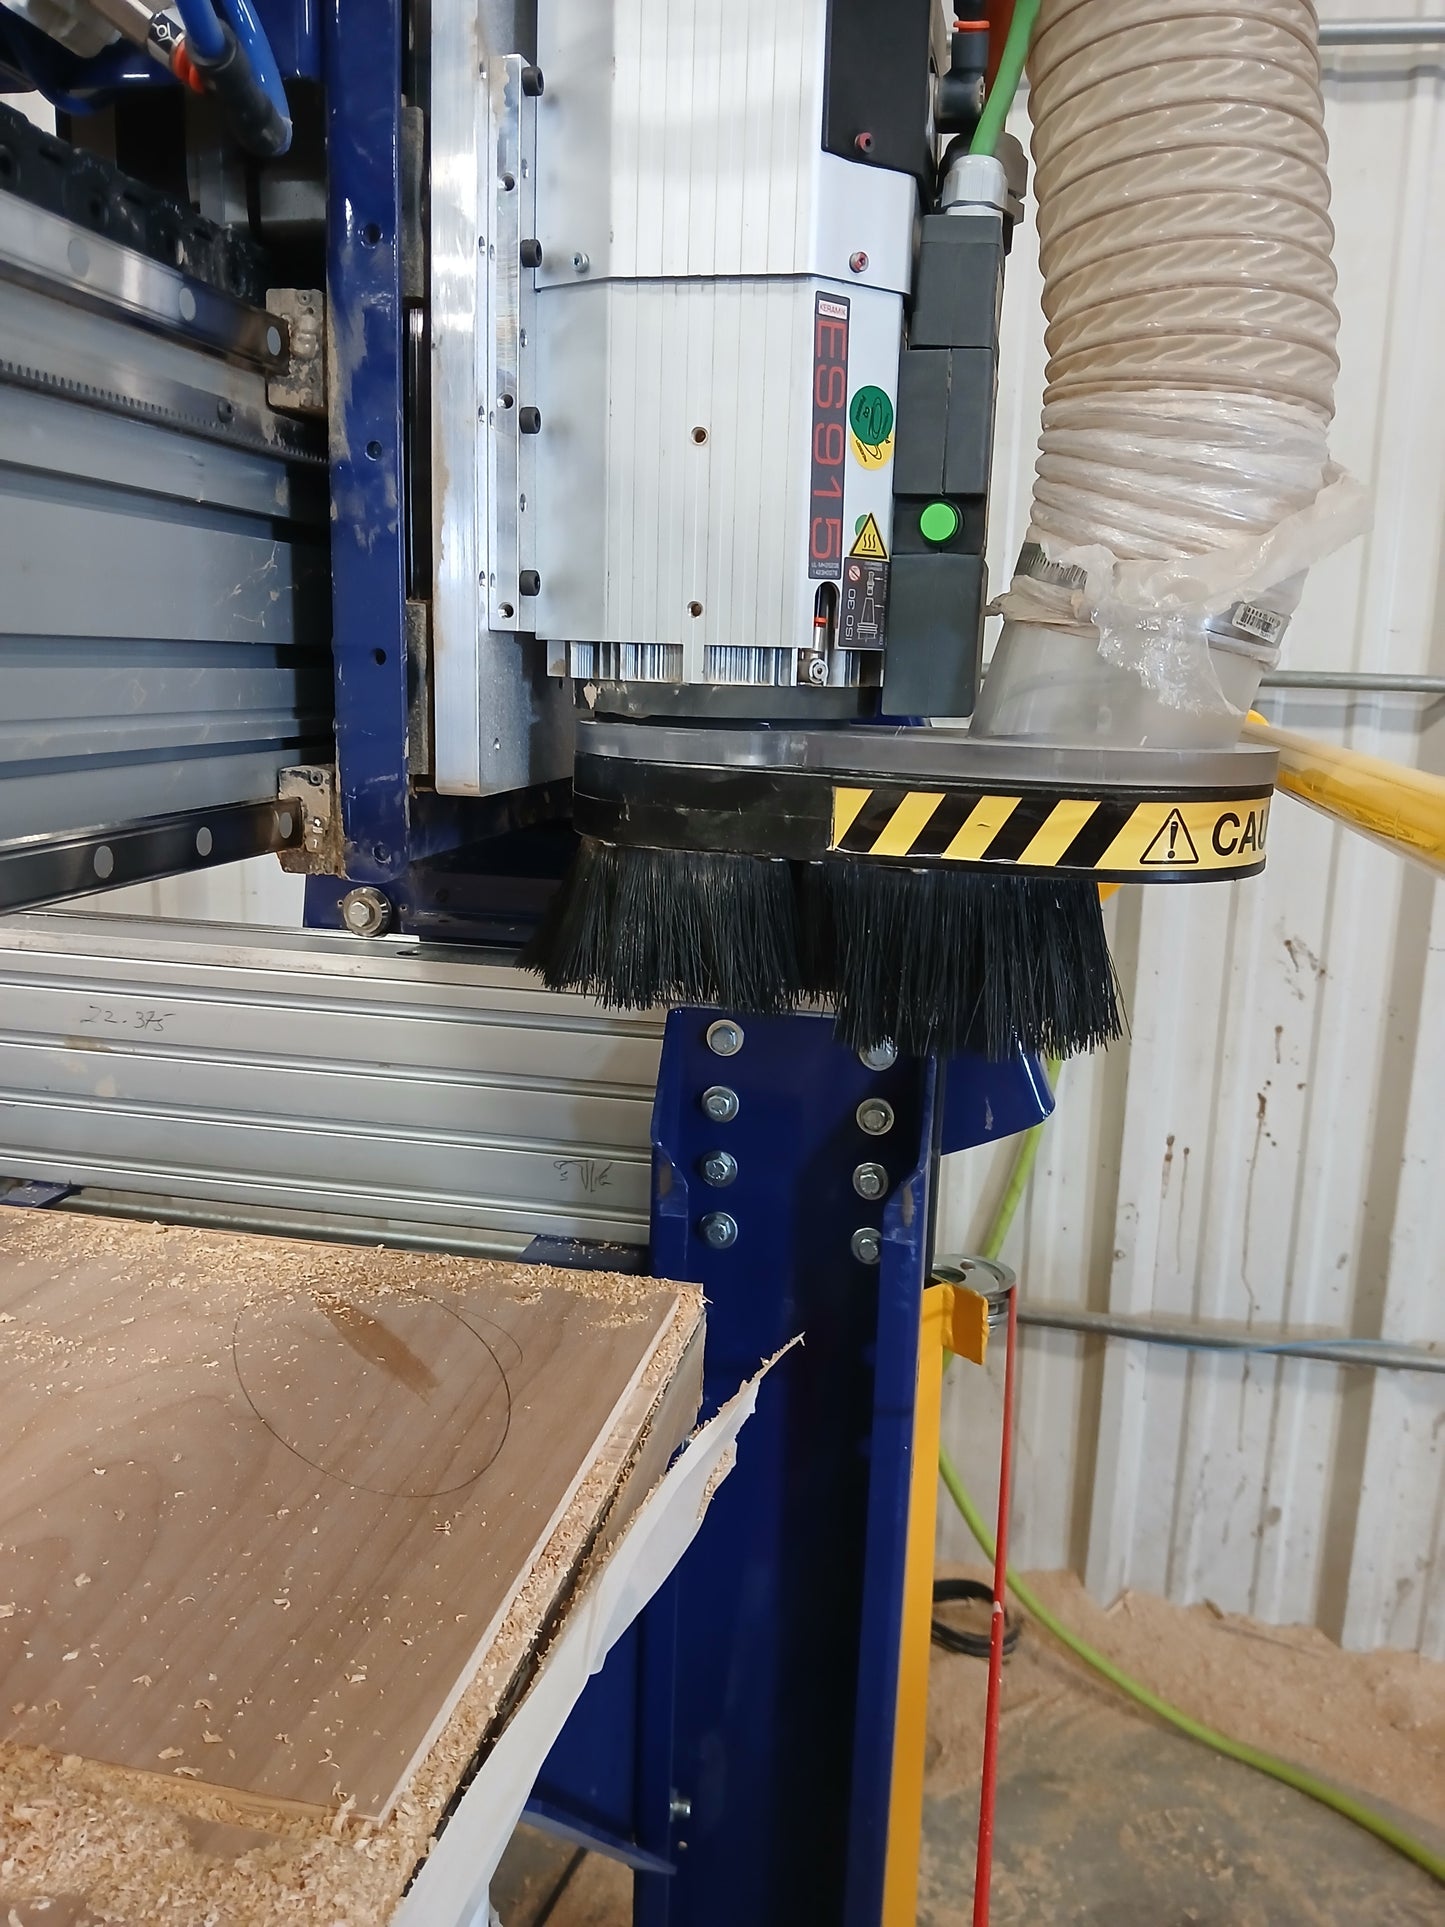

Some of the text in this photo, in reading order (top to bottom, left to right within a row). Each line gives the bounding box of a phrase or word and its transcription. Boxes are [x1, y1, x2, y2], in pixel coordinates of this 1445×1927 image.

[845, 588, 856, 641] ISO 30
[1211, 809, 1268, 857] CAU
